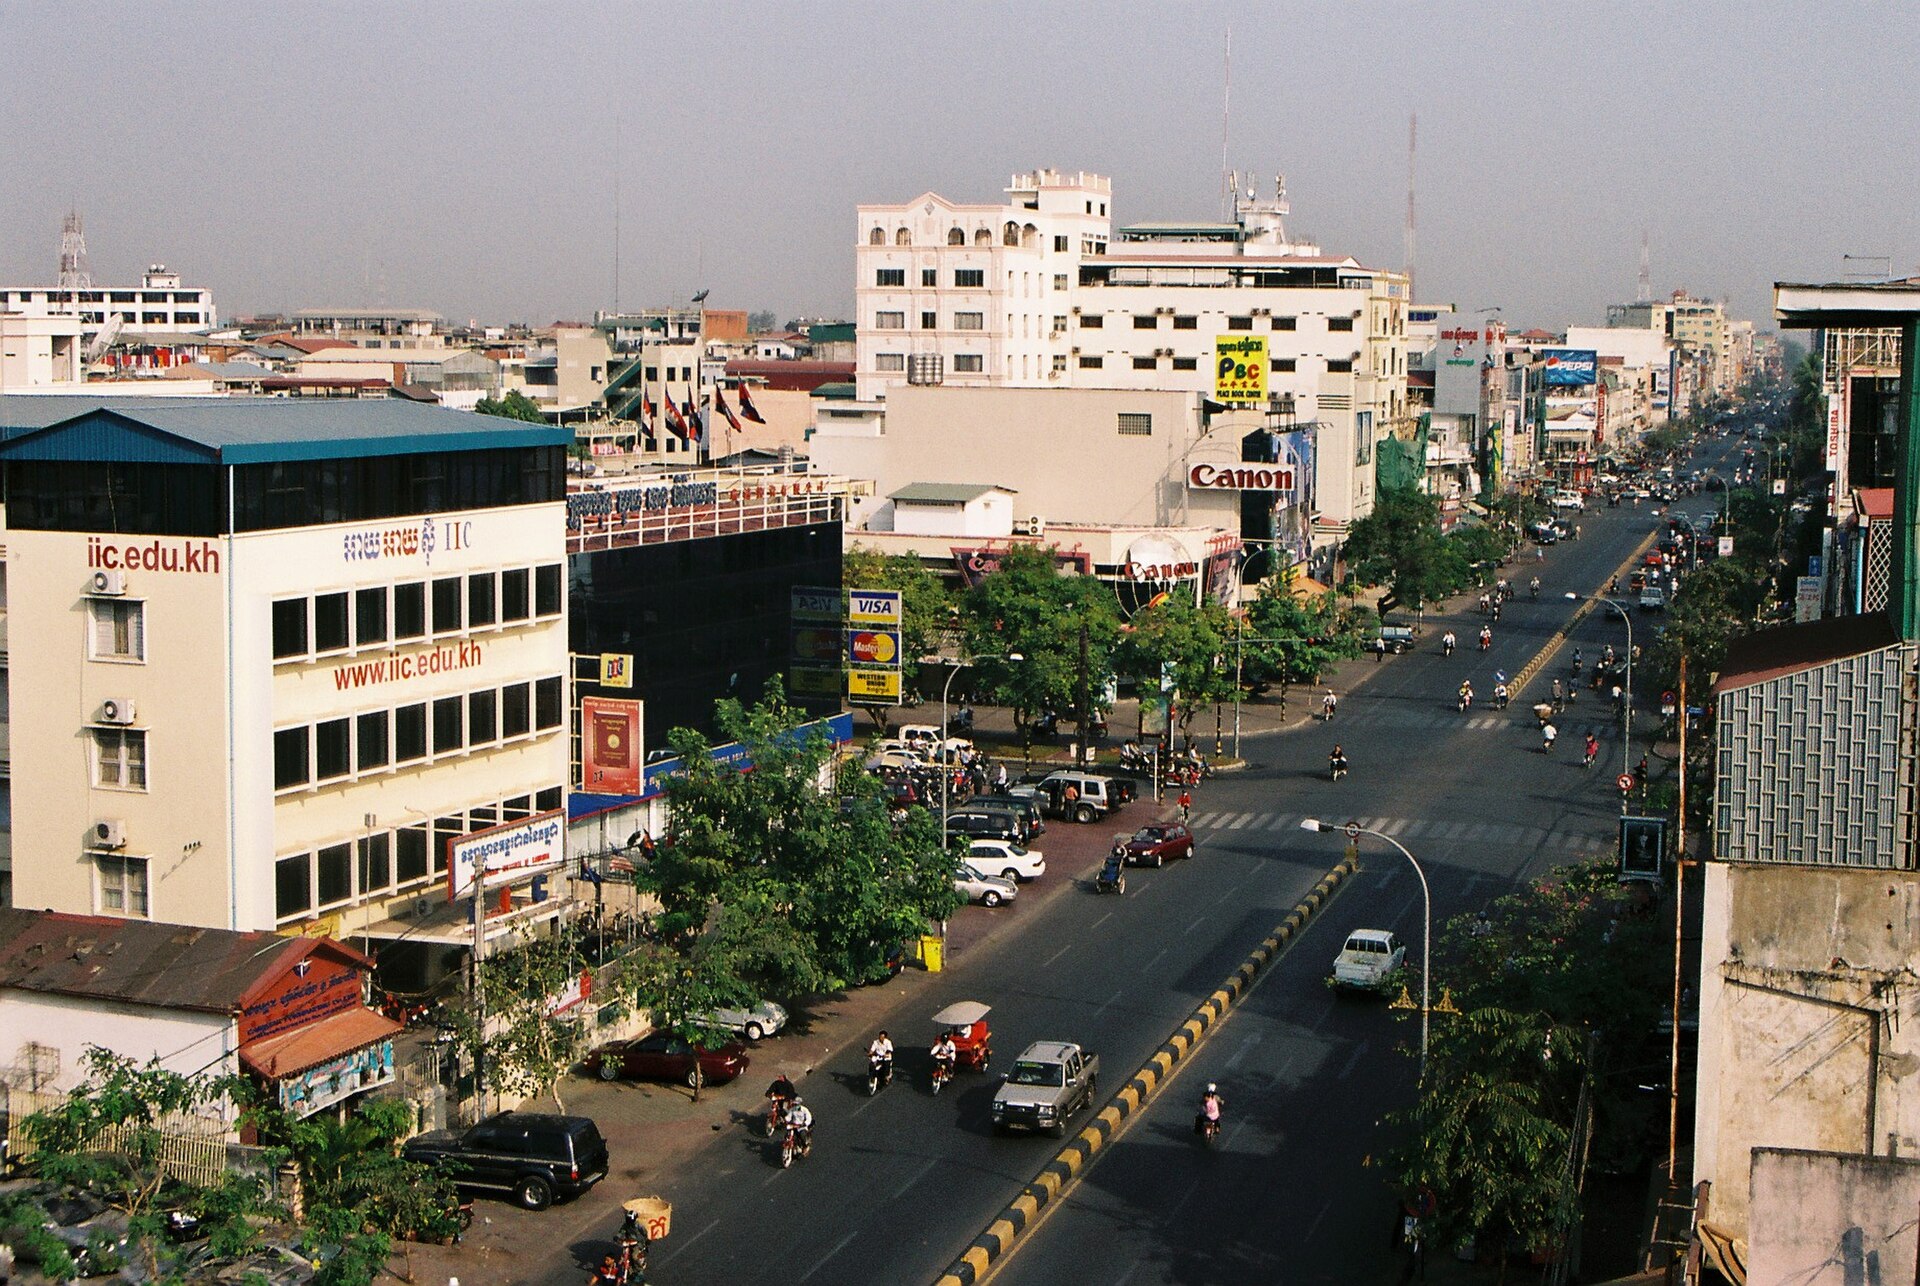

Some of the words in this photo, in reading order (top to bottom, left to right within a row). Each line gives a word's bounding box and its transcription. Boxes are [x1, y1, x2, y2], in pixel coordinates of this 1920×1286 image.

[1218, 357, 1260, 379] PBC
[1559, 361, 1593, 371] PEPSI
[1829, 409, 1838, 457] TOSHIBA
[1191, 464, 1292, 489] Canon
[444, 521, 472, 551] IIC
[88, 536, 219, 573] iic.edu.kh
[859, 600, 892, 614] VISA
[334, 639, 481, 691] www.iic.edu.kh
